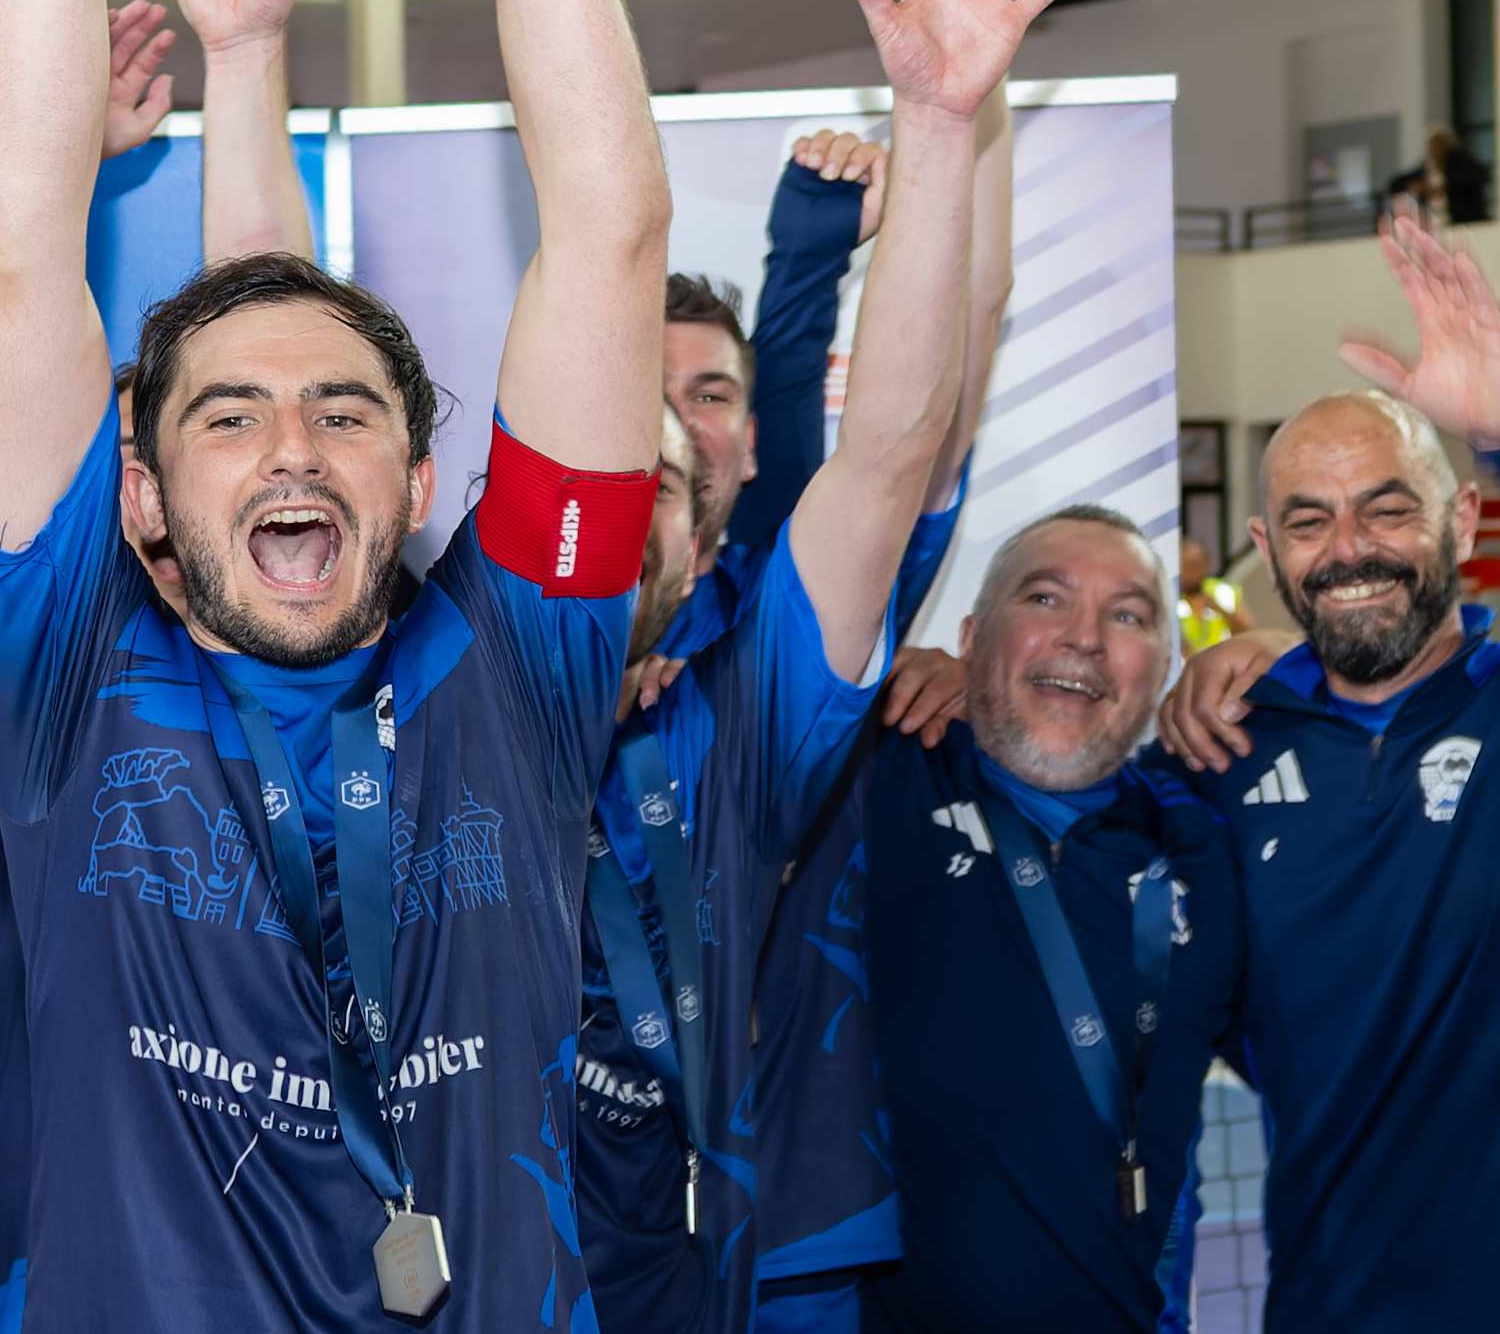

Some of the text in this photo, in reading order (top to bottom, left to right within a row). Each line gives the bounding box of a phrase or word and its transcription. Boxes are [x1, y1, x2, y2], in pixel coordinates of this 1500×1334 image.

[946, 852, 976, 878] 12
[129, 1023, 257, 1094] axione
[260, 1111, 341, 1141] depui
[597, 1104, 643, 1129] 1997
